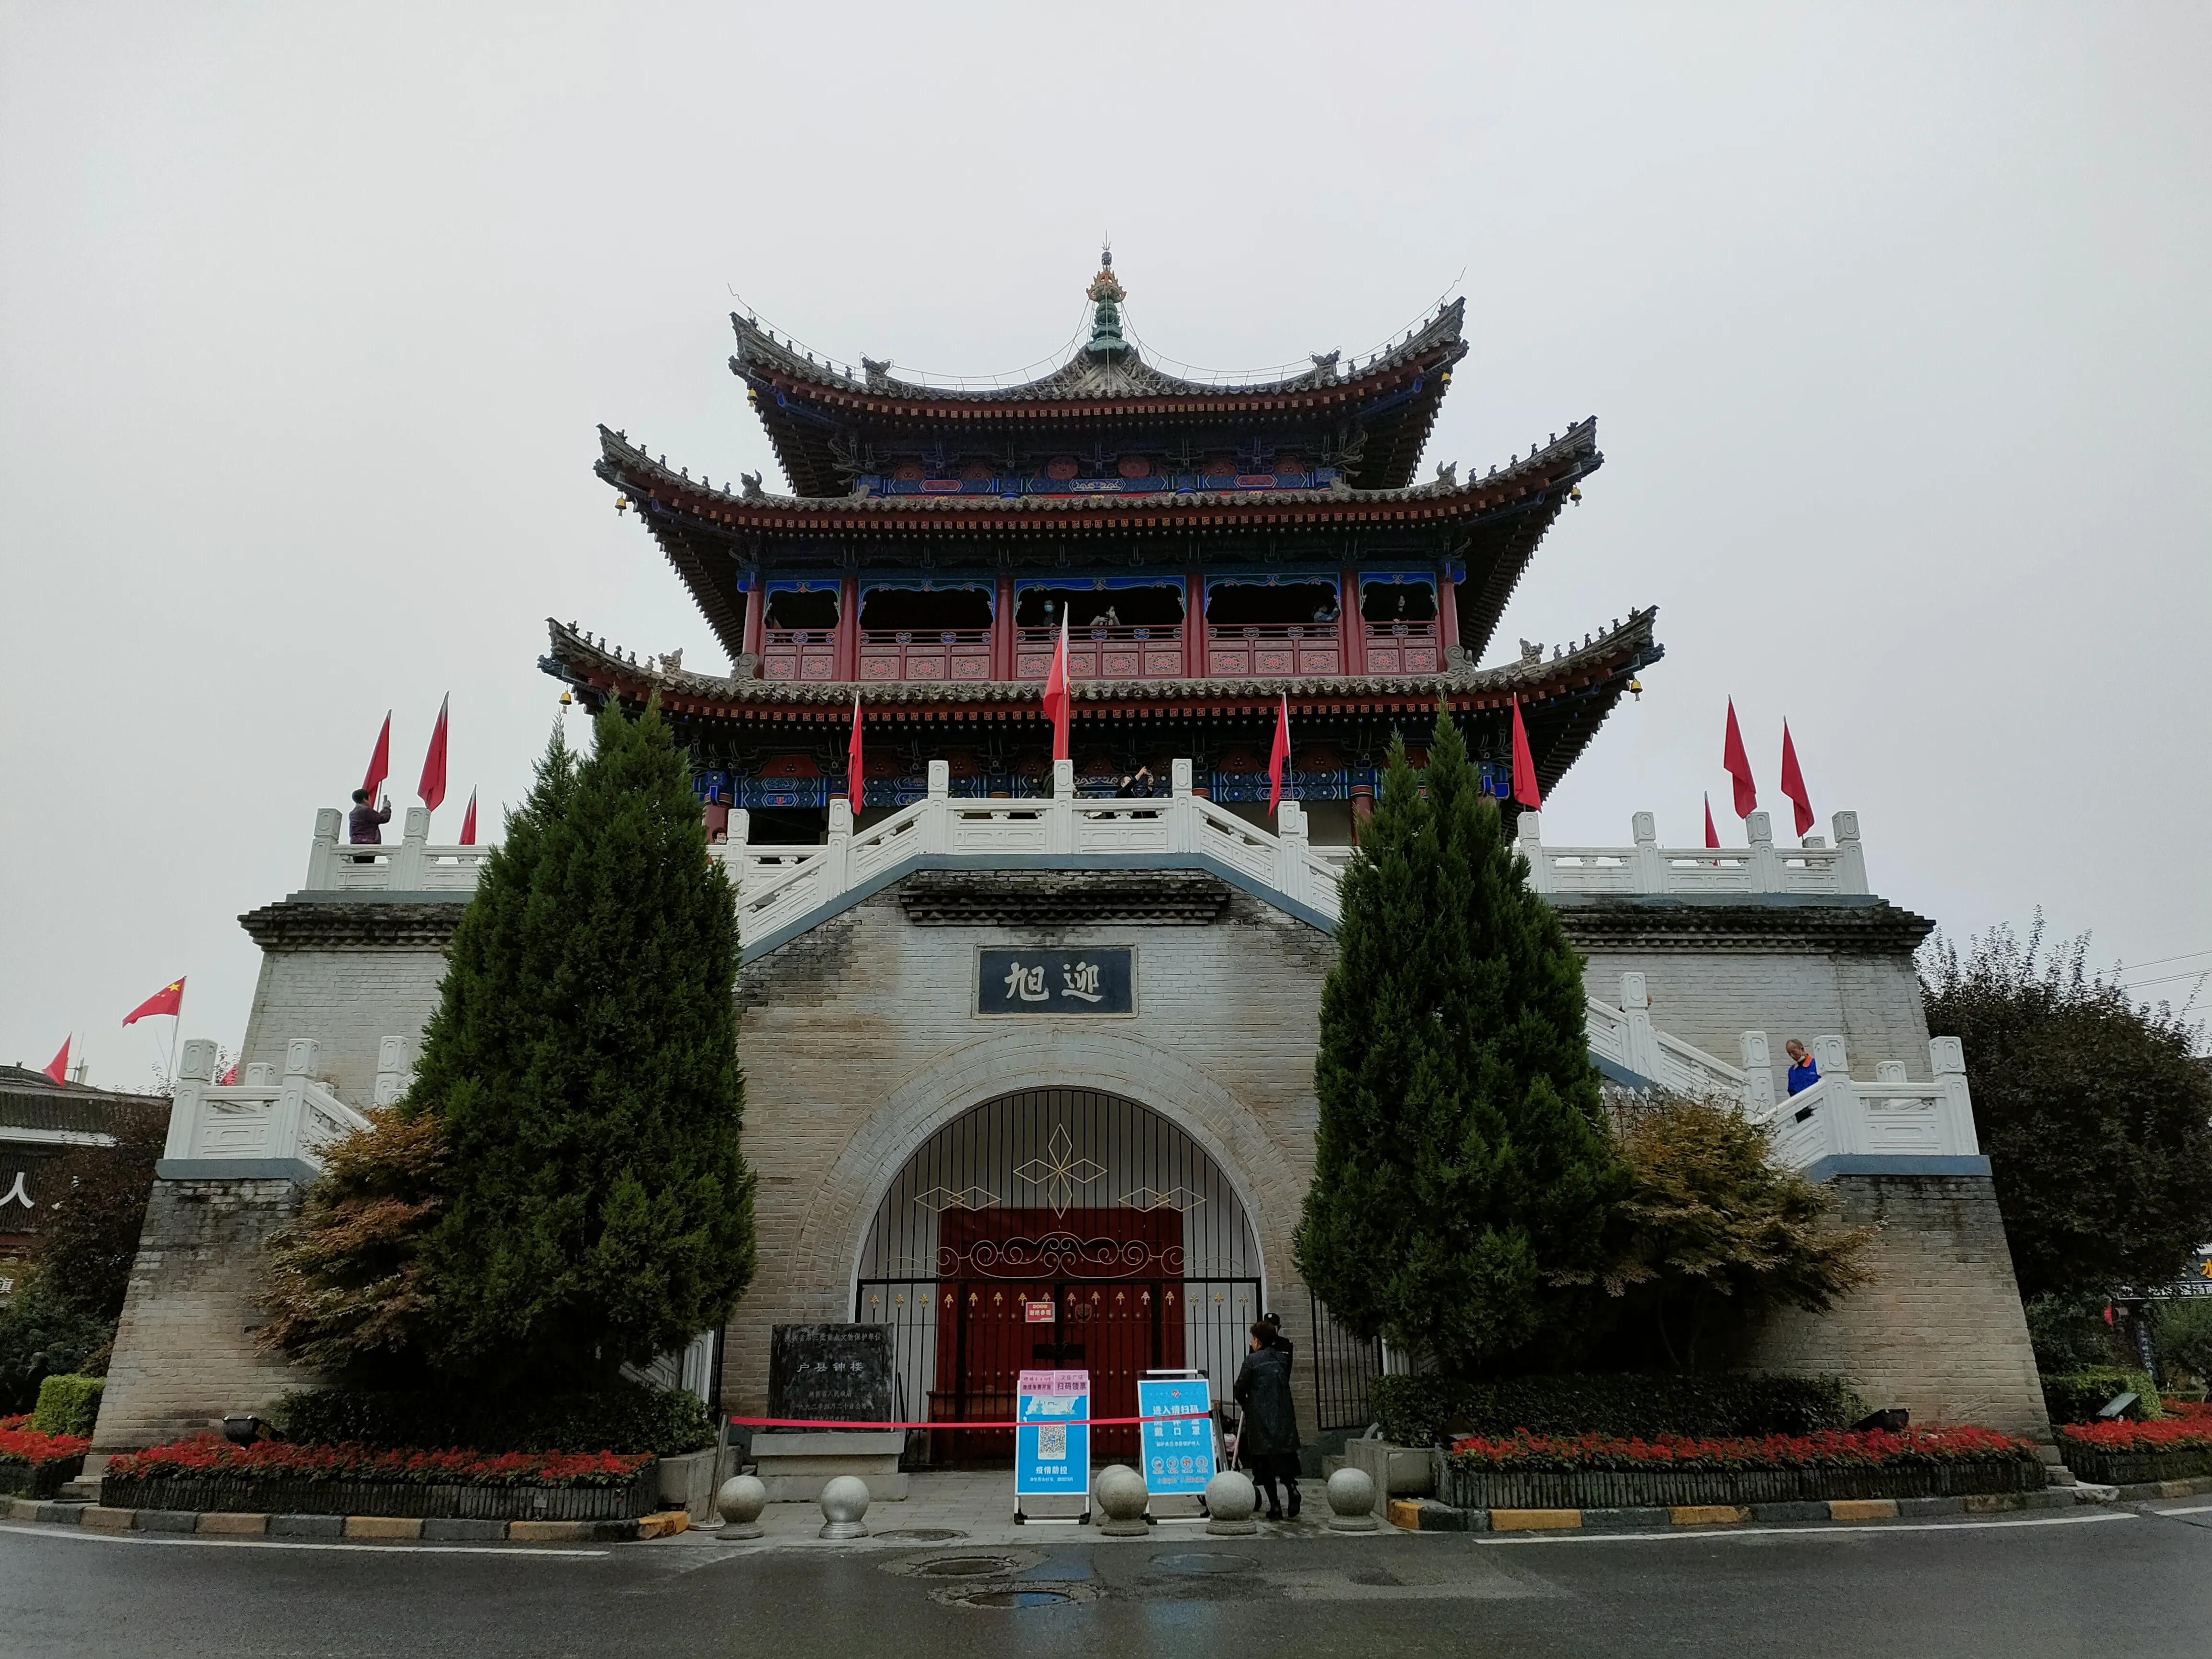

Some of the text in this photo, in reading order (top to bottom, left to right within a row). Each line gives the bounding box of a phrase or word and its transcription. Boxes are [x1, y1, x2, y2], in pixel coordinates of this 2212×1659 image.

[796, 1362, 864, 1372] 户县钟楼
[1058, 1382, 1086, 1390] 扫码领票
[1153, 1405, 1199, 1415] 进入请扫码
[1036, 1466, 1068, 1474] 疫情防控
